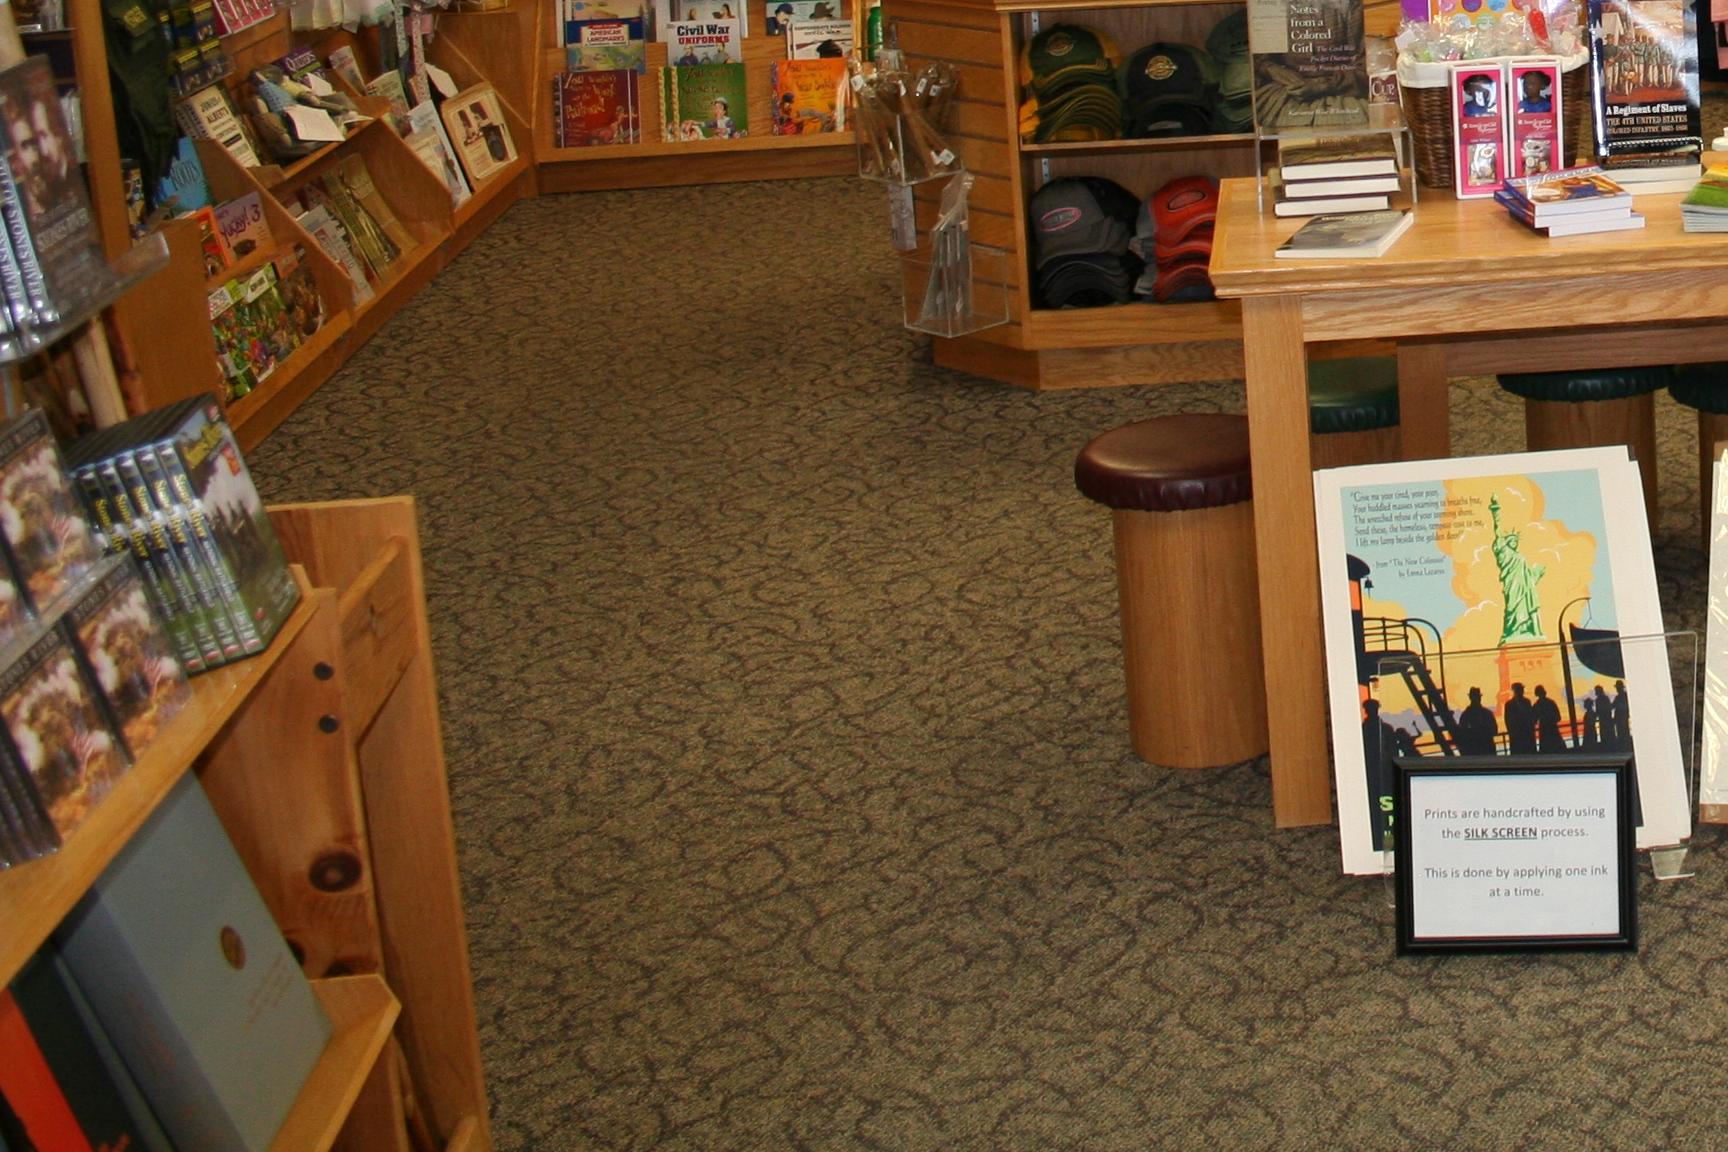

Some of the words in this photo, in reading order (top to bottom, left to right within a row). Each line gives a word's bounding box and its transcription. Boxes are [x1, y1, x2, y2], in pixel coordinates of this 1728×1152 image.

[1290, 4, 1318, 14] Notes
[1290, 18, 1315, 27] from
[677, 25, 704, 36] Civil
[706, 24, 730, 35] War
[1291, 29, 1331, 40] Colored
[678, 35, 730, 45] UNIFORMS
[1292, 43, 1313, 53] Girl
[1606, 106, 1612, 115] A
[1613, 106, 1651, 116] Regiment
[1652, 104, 1660, 113] of
[1661, 104, 1686, 112] Slaves
[1622, 117, 1634, 125] 4TH
[1636, 116, 1661, 124] UNITED
[1663, 115, 1687, 123] STATES
[1424, 809, 1458, 818] Prints
[1461, 810, 1479, 818] are
[1483, 807, 1554, 818] handcrafted
[1558, 807, 1571, 819] by
[1575, 807, 1606, 818] using
[1442, 829, 1461, 838] the
[1464, 828, 1488, 839] SILK
[1492, 827, 1538, 839] SCREEN
[1541, 829, 1589, 839] process.
[1424, 868, 1448, 878] This
[1451, 868, 1459, 878] is
[1463, 867, 1493, 878] done
[1496, 867, 1509, 879] by
[1513, 866, 1562, 879] applying
[1565, 867, 1587, 876] one
[1591, 865, 1608, 876] ink
[1489, 887, 1500, 897] at
[1504, 889, 1510, 897] a
[1514, 887, 1544, 896] time.
